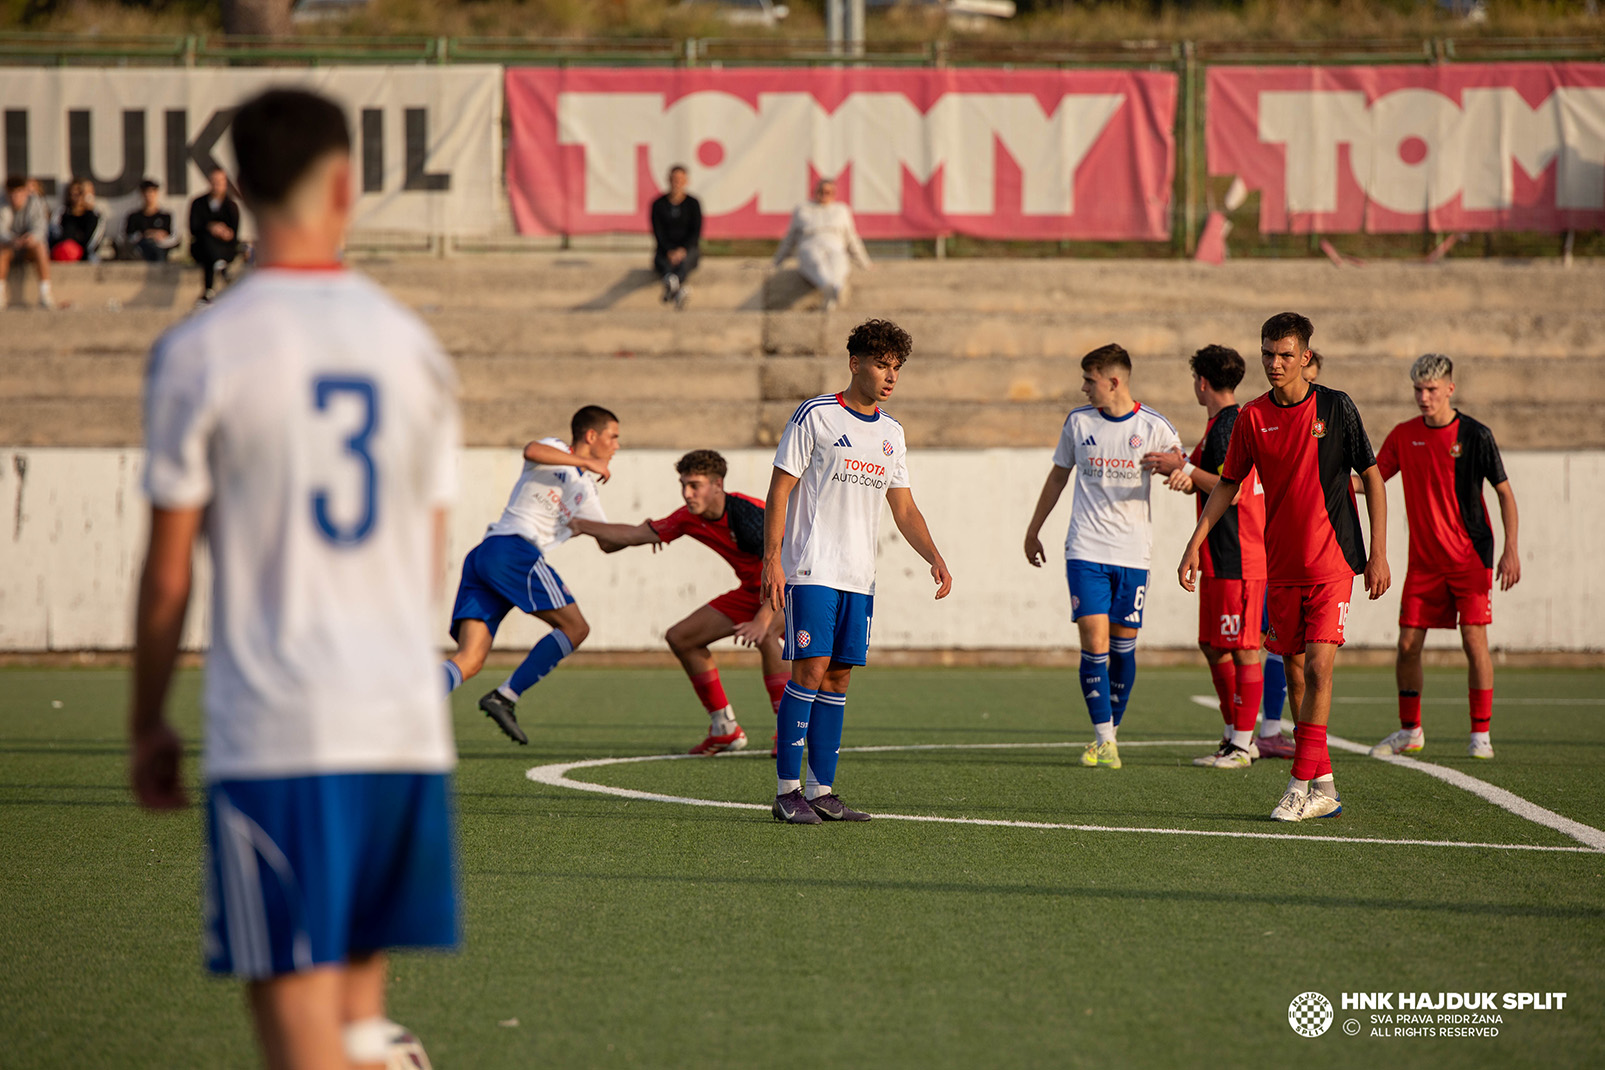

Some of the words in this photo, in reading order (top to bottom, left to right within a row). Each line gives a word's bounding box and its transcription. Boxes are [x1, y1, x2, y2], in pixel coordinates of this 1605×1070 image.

[4, 108, 451, 197] LUKIL
[557, 90, 1125, 216] TOMMY
[311, 374, 380, 550] 3
[844, 458, 886, 477] TOYOTA
[1088, 457, 1135, 469] TOYOTA
[831, 472, 859, 484] AUTO
[1083, 469, 1103, 478] AUTO
[1134, 586, 1146, 610] 6
[1220, 614, 1241, 635] 20
